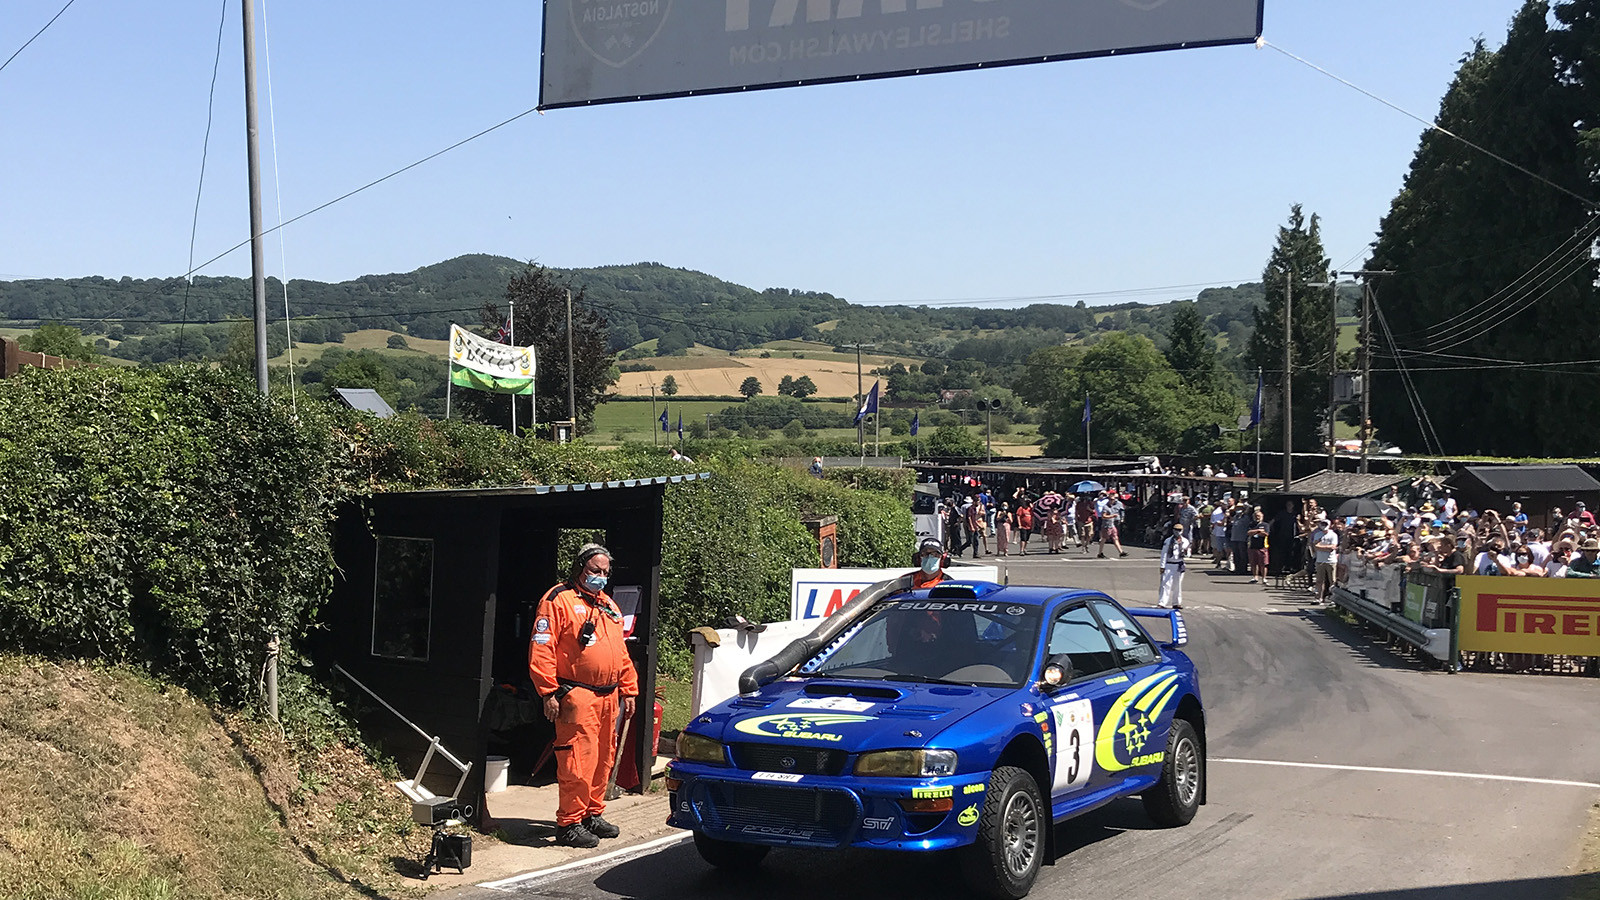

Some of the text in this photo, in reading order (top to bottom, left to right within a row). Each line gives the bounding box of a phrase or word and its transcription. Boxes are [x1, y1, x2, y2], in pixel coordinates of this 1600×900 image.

[898, 602, 998, 612] SUBARU
[1476, 593, 1600, 635] PIRE
[782, 730, 843, 742] SUBARU
[1067, 728, 1080, 785] 3
[1131, 751, 1165, 767] SUBARU
[912, 785, 953, 798] PIRELLI
[963, 783, 984, 794] alcon
[741, 825, 815, 837] prodrive
